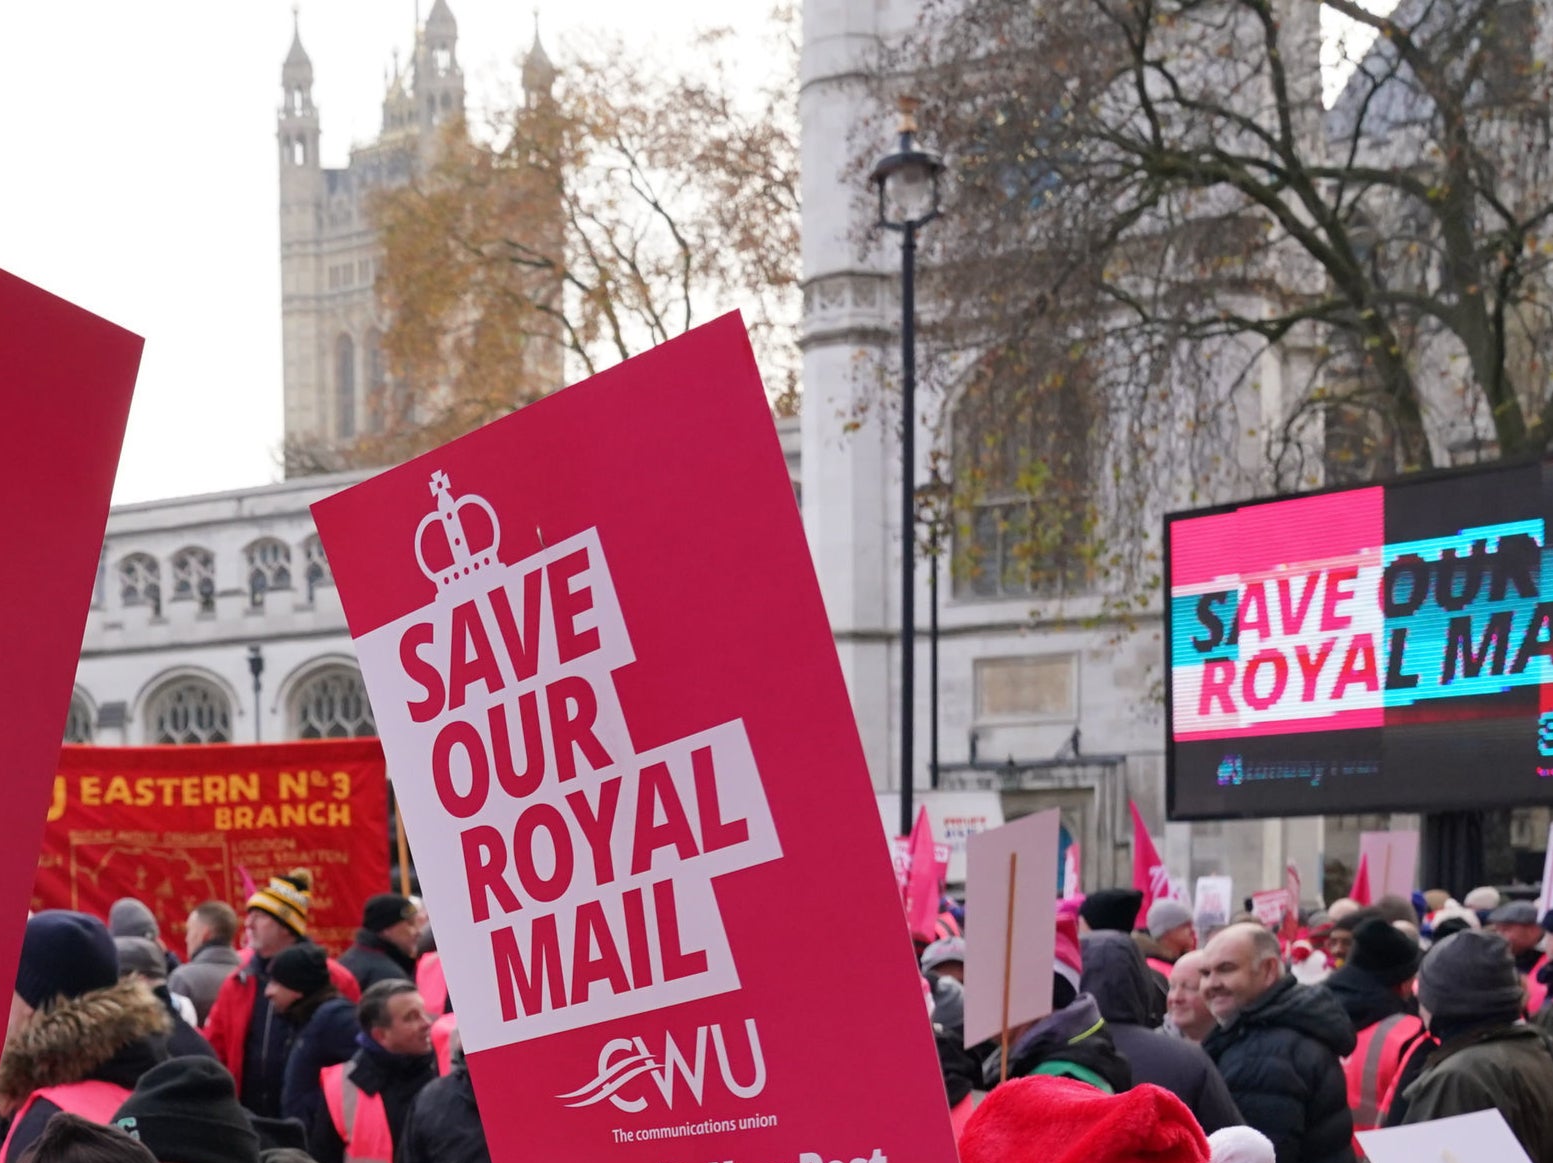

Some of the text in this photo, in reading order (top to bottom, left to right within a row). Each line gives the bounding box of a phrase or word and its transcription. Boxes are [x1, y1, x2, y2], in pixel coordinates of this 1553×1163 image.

[1190, 564, 1359, 653] SAVE
[1379, 531, 1542, 619] OUR
[398, 546, 601, 723] SAVE
[1198, 627, 1419, 716] ROYAL
[80, 773, 261, 806] EASTERN
[432, 675, 614, 818] OUR
[214, 802, 351, 830] BRANCH
[460, 744, 750, 923] ROYAL
[490, 879, 708, 1022] MAIL
[554, 1018, 767, 1113] CWU
[612, 1114, 778, 1144] The communications union
